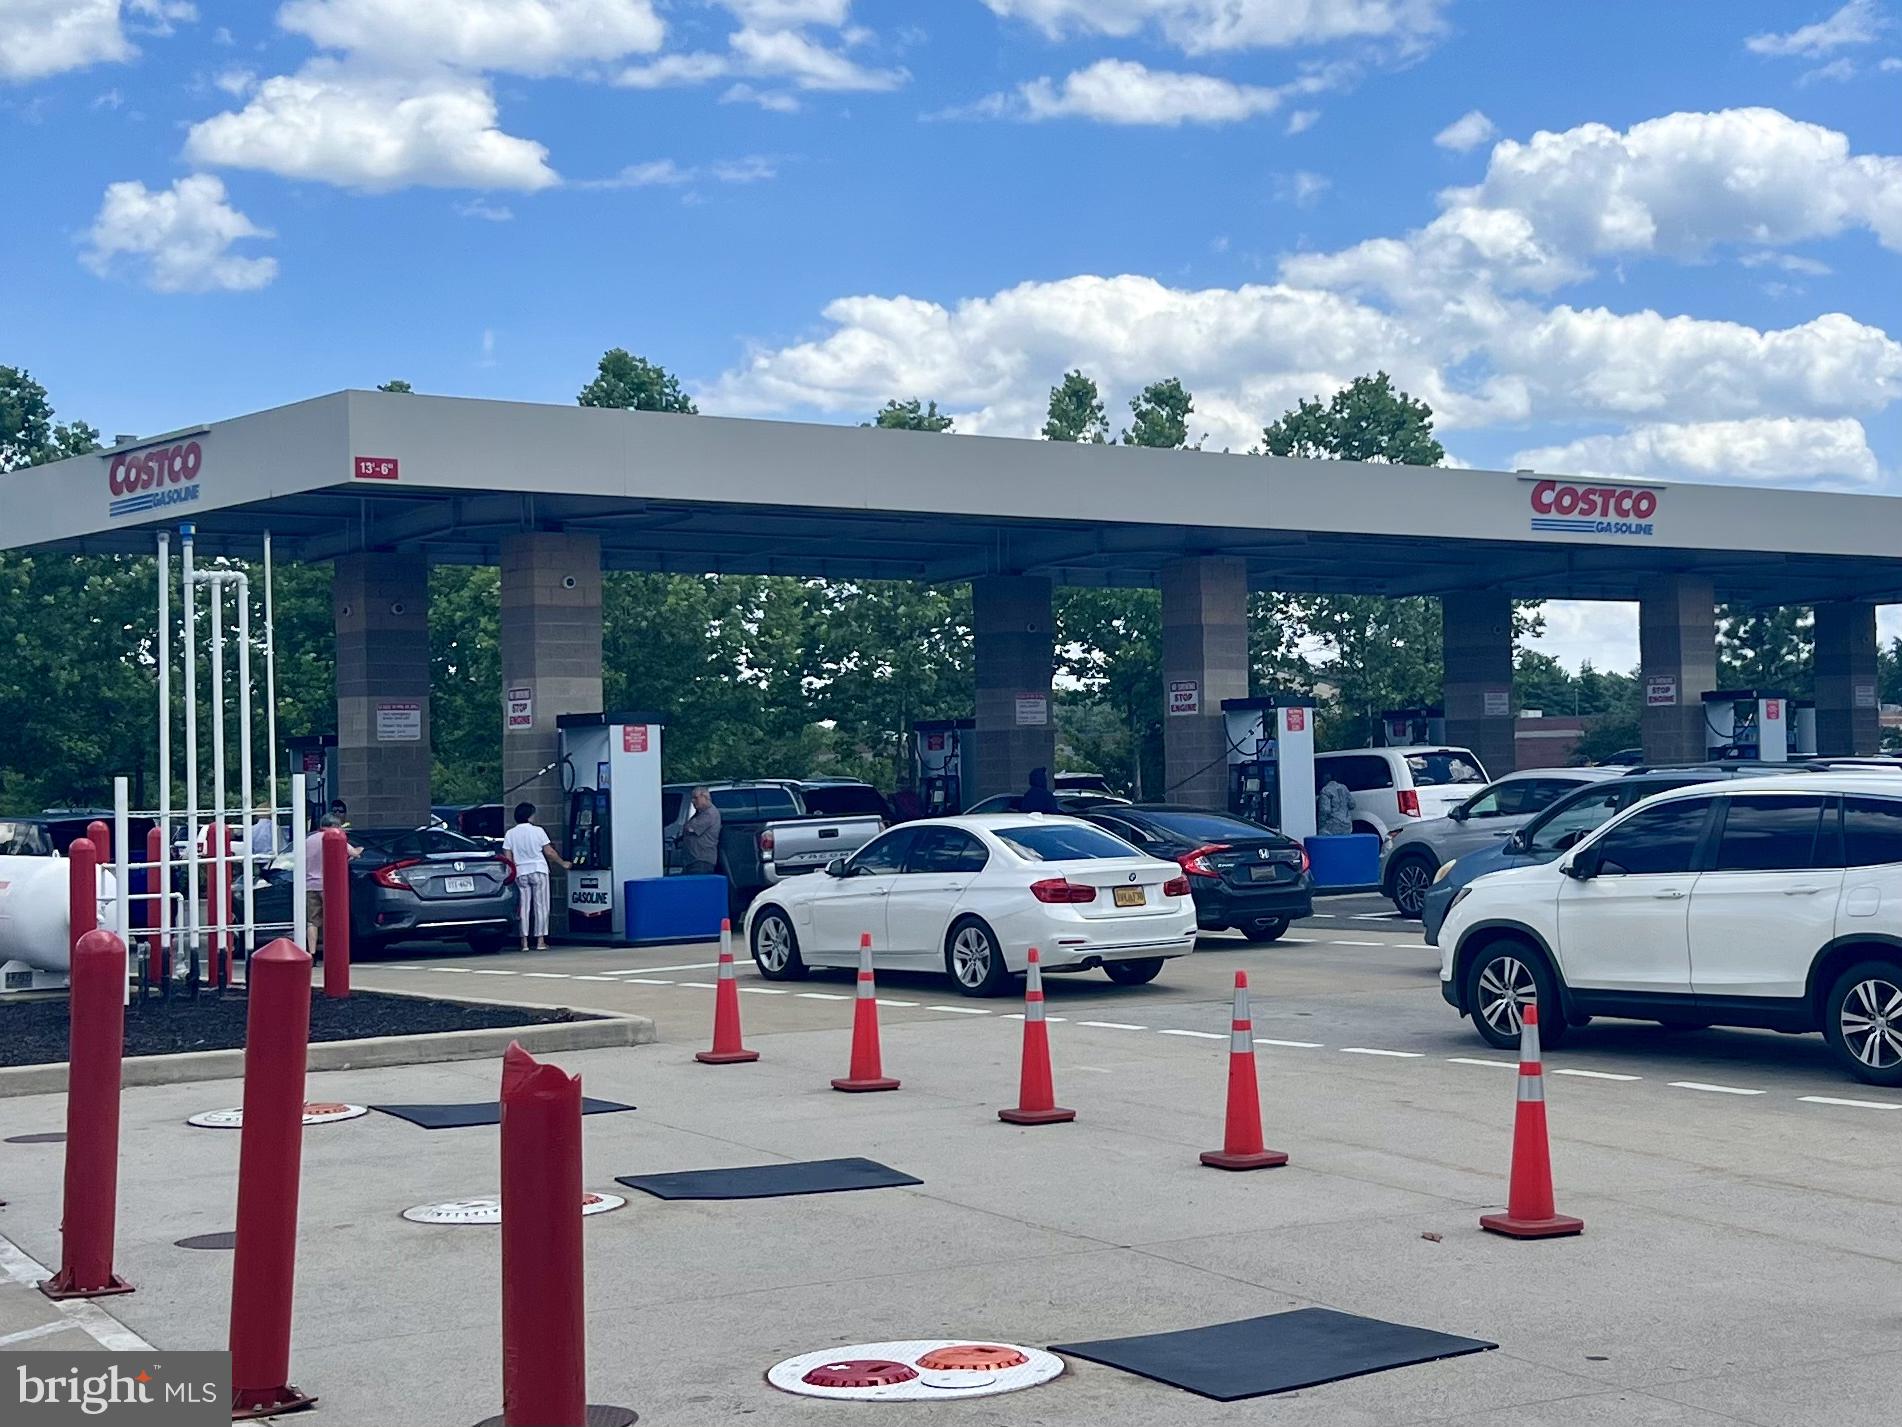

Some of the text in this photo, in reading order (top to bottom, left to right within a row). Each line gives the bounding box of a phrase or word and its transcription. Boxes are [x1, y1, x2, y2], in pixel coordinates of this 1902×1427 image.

[109, 441, 202, 496] COSTCO
[152, 484, 201, 508] GASOLINE
[1531, 480, 1657, 519] COSTCO
[1595, 520, 1654, 535] GASOLINE
[1652, 686, 1671, 695] STOP
[1175, 693, 1193, 702] STOP
[512, 703, 528, 713] STOP
[1171, 703, 1197, 712] ENGINE
[572, 892, 608, 904] GASOLINE
